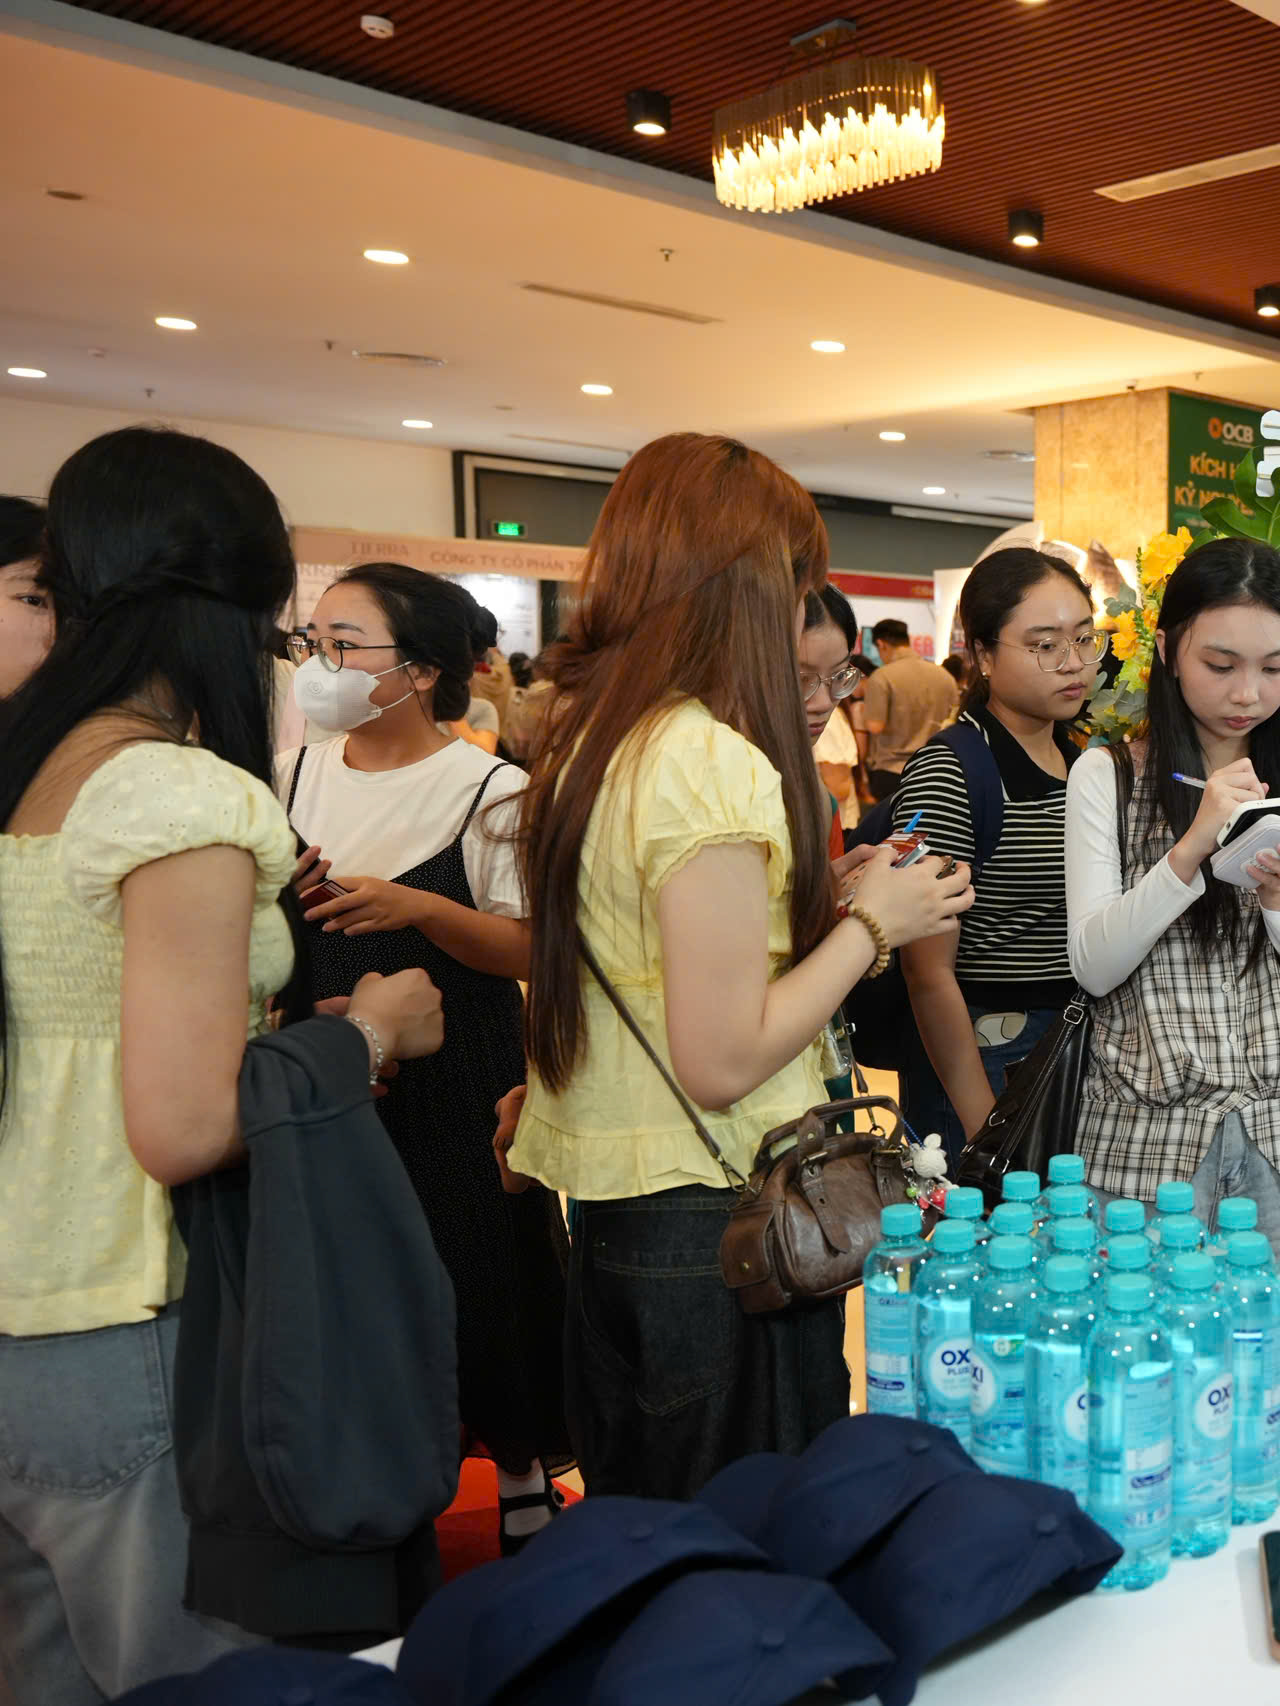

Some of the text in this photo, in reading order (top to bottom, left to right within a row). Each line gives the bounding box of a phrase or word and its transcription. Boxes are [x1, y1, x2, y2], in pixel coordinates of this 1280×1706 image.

[1222, 422, 1253, 443] OCB
[1190, 451, 1227, 479] KÍCH
[941, 1349, 971, 1366] OX
